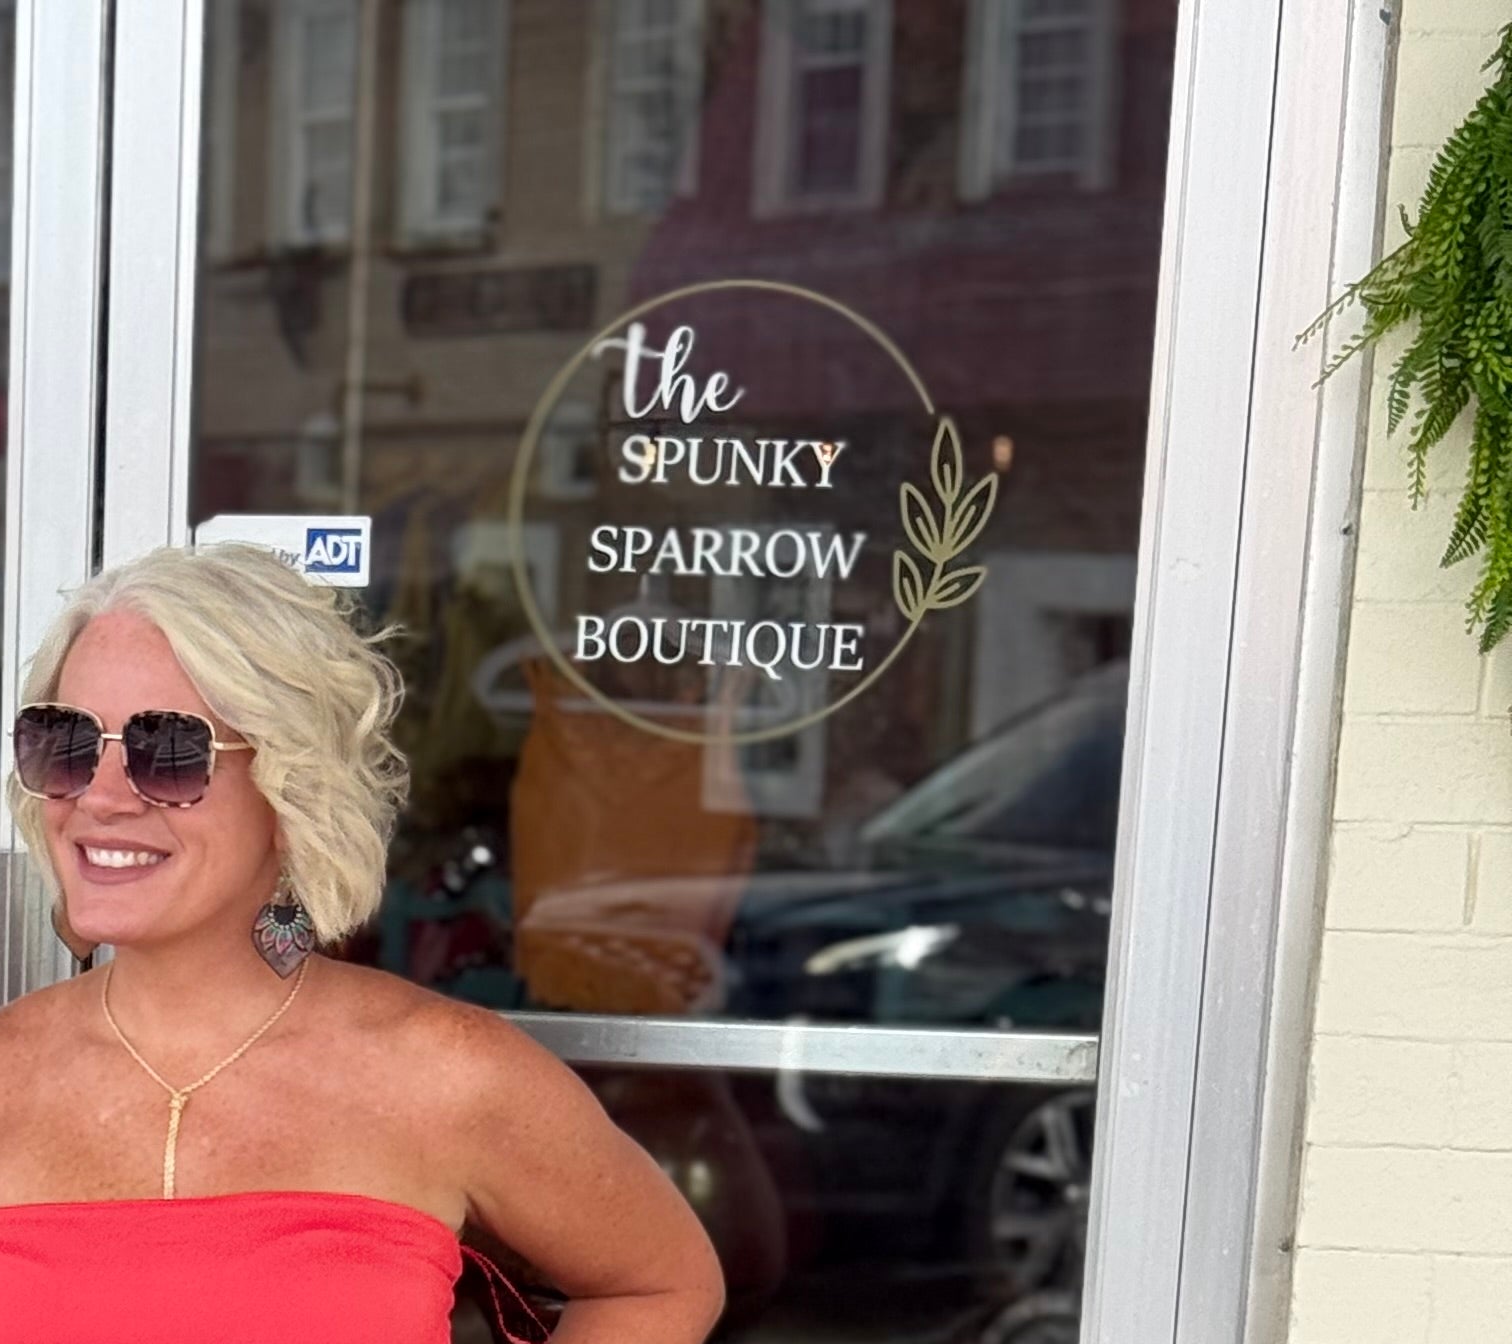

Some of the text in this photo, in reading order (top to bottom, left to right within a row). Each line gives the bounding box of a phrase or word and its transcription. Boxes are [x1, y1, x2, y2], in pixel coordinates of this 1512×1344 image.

[592, 323, 746, 423] the
[618, 434, 847, 488] SPUNKY
[307, 533, 362, 566] ADT
[588, 524, 867, 581] SPARROW
[574, 615, 865, 680] BOUTIQUE
